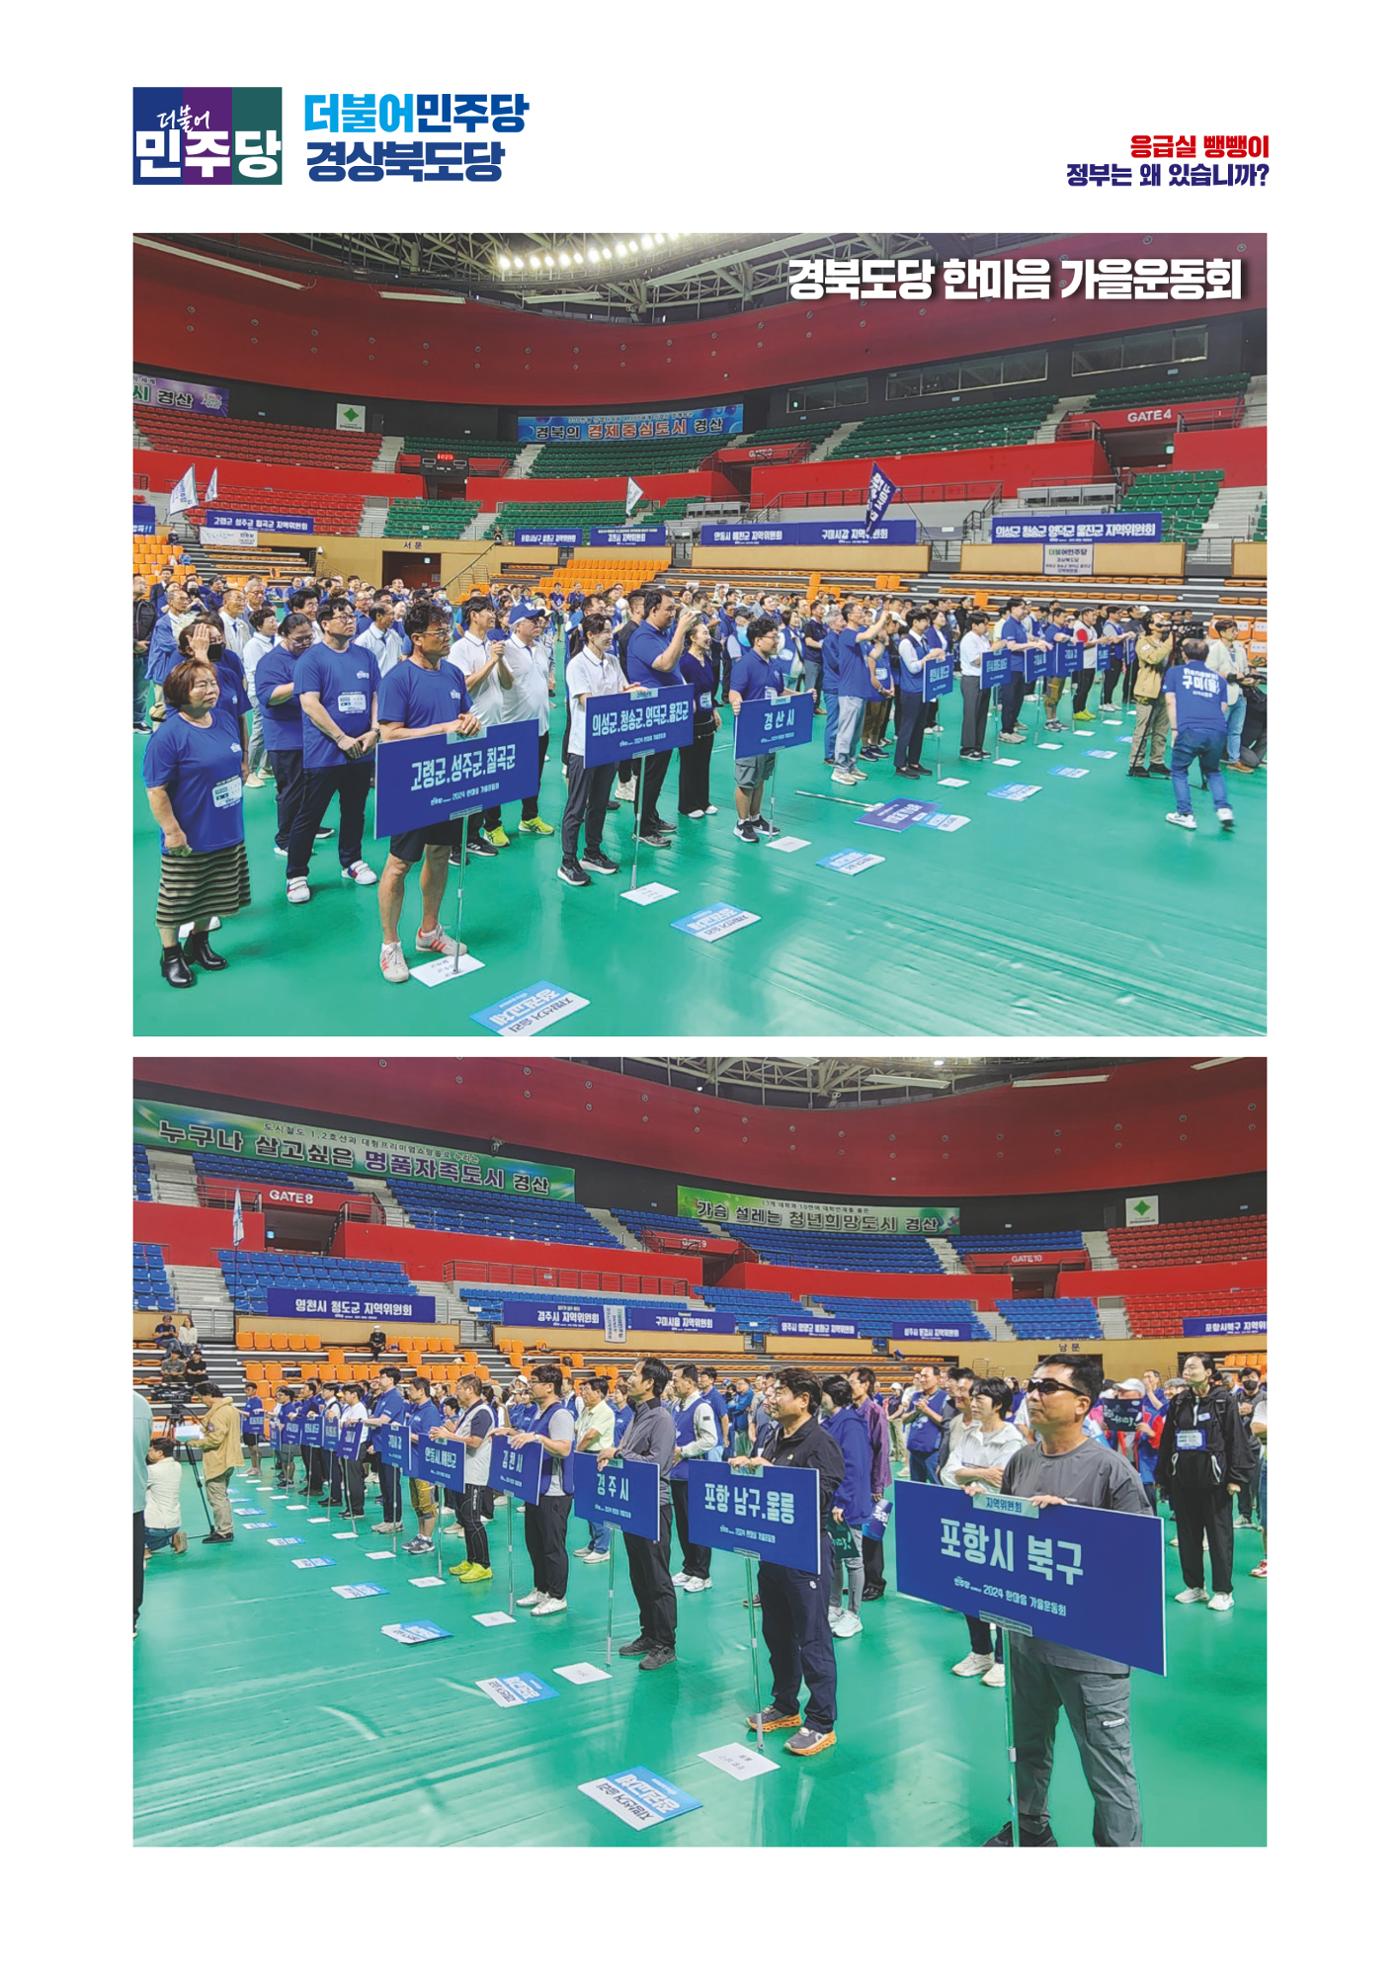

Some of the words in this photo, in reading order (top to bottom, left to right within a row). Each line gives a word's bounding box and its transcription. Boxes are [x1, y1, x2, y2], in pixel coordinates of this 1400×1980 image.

[158, 389, 193, 408] 경산
[535, 425, 580, 440] 경북의
[588, 419, 687, 439] 경제중심도시
[694, 417, 724, 432] 경산
[1105, 522, 1155, 537] 지역위원회
[264, 1122, 305, 1136] 도시철도
[158, 1119, 244, 1152] 누구나
[255, 1135, 355, 1167] 살고싶은
[364, 1149, 506, 1189] 명품자족도시
[512, 1173, 550, 1194] 경산
[696, 1200, 729, 1219] 가슴
[735, 1206, 784, 1226] 설레는
[788, 1209, 899, 1233] 청년희망도시
[904, 1217, 940, 1234] 경산
[295, 1298, 327, 1314] 영천시
[331, 1299, 361, 1315] 청도군
[363, 1302, 413, 1317] 지역위원회
[537, 1309, 560, 1322] 경주시
[562, 1311, 600, 1325] 지역위원회
[704, 1482, 731, 1513] 포항
[985, 1496, 1022, 1513] 지역위원회
[939, 1517, 1014, 1572] 포항시
[1027, 1534, 1084, 1586] 북구
[983, 1584, 1004, 1600] 2024
[1005, 1588, 1028, 1607] 한마음
[1029, 1595, 1067, 1617] 가을운동회
